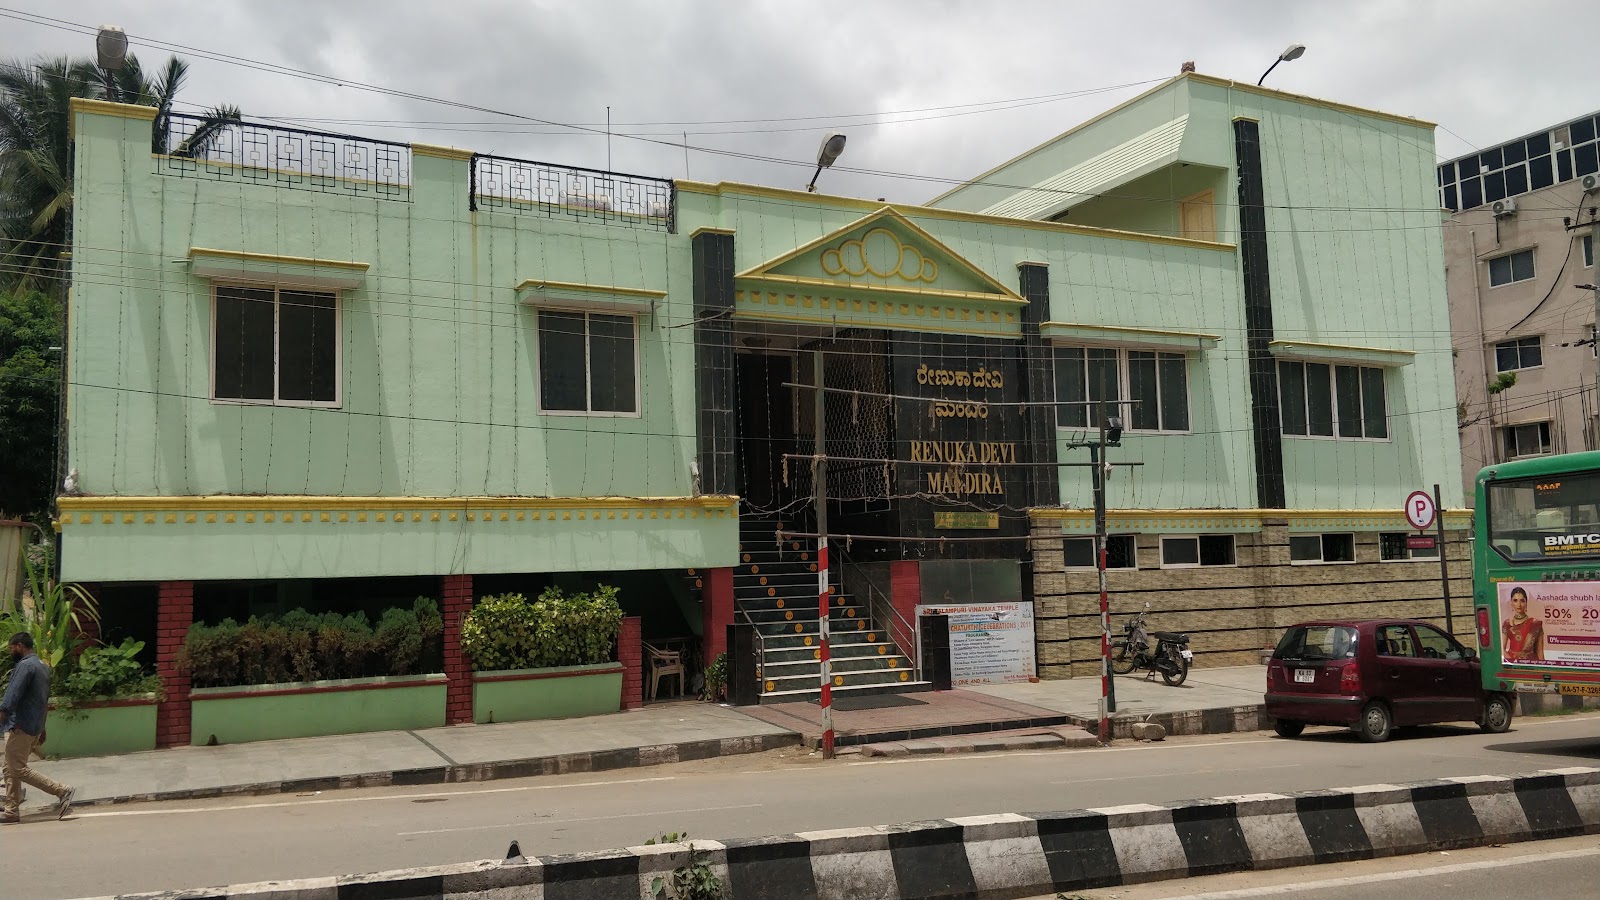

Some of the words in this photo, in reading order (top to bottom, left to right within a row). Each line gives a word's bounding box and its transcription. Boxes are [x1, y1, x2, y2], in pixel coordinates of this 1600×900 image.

[917, 363, 971, 386] ರೇಣುಕಾ
[972, 367, 1004, 389] ದೇವಿ
[910, 440, 978, 463] RENUKA
[980, 441, 1017, 464] DEVI
[1415, 500, 1426, 518] P
[1544, 533, 1600, 545] BMTC
[1544, 608, 1572, 619] 50%
[1582, 608, 1600, 619] 20
